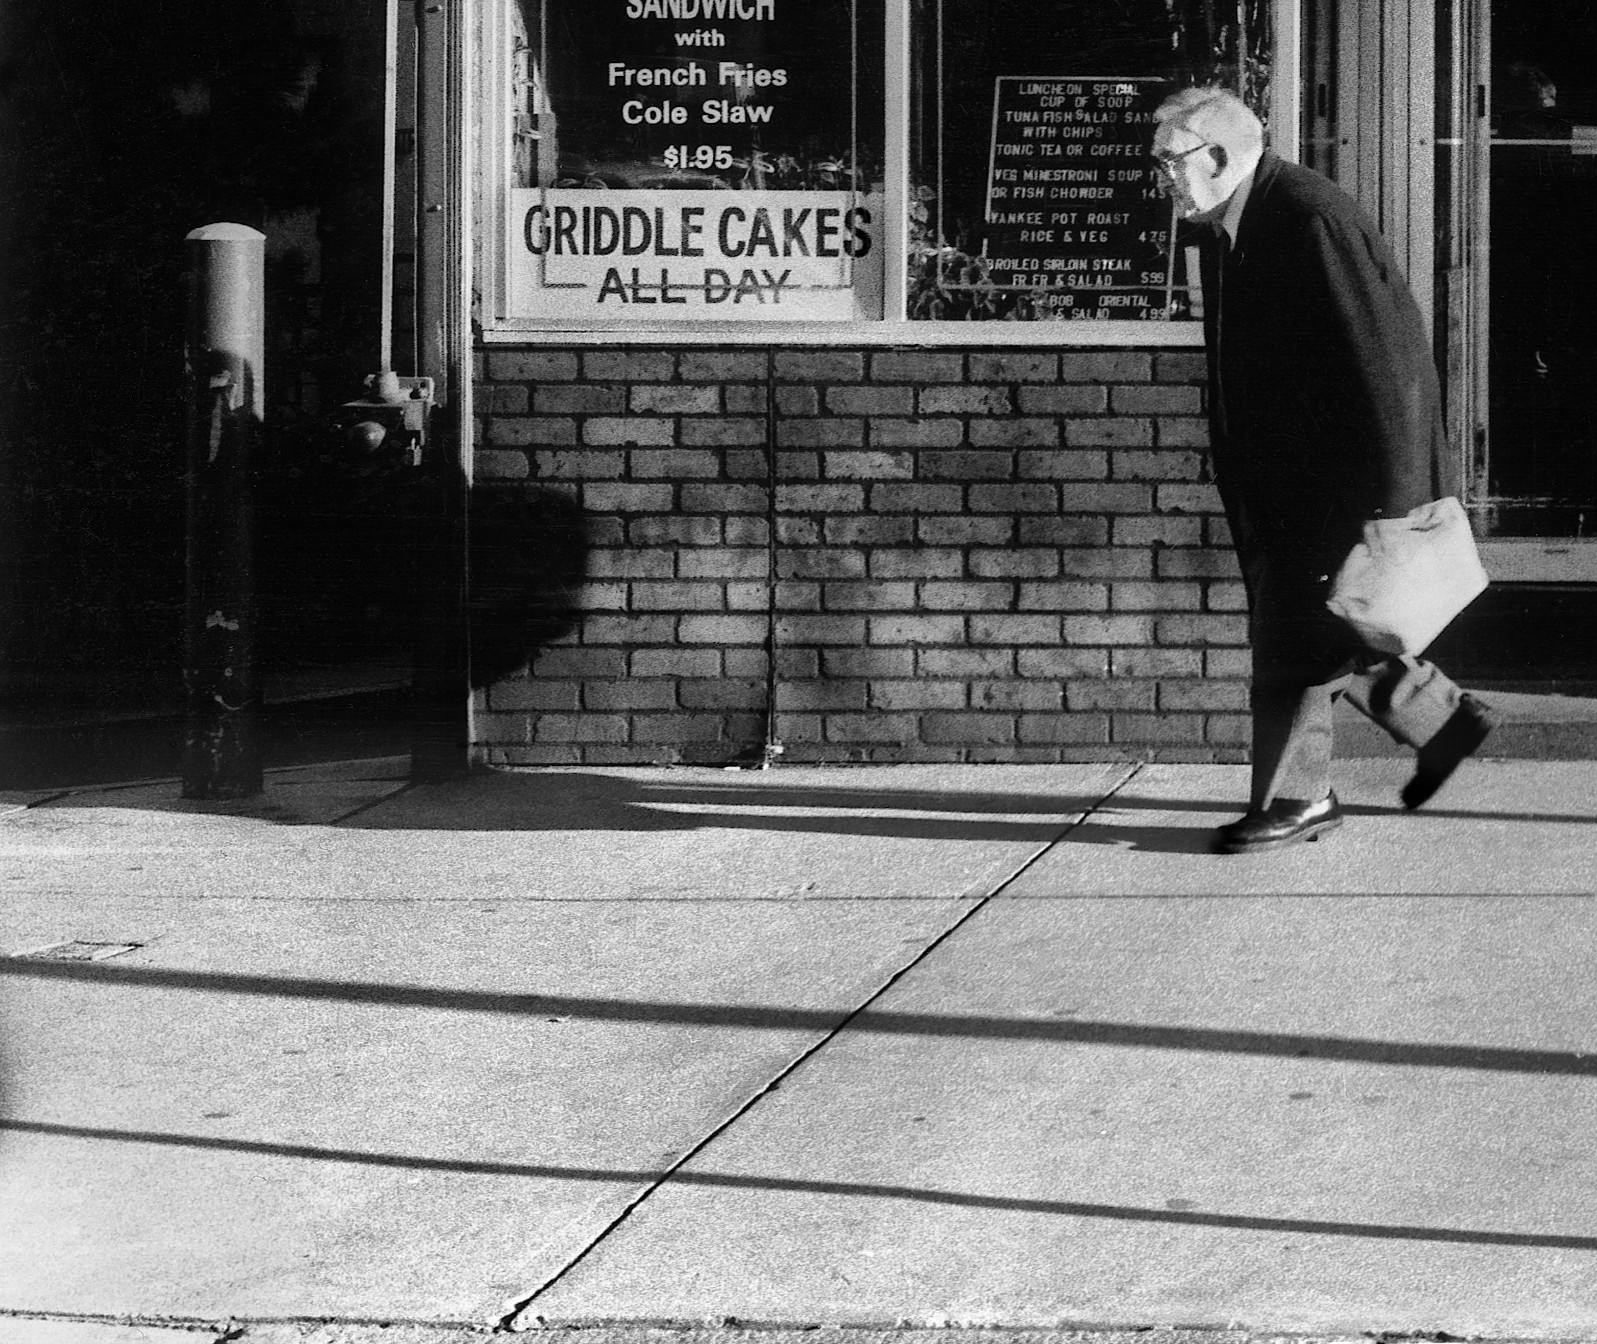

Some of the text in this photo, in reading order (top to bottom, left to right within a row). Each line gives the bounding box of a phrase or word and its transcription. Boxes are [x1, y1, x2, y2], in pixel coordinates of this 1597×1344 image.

[674, 30, 725, 47] with
[608, 62, 787, 87] French Fries
[1019, 84, 1082, 95] LUNCHEON
[1040, 97, 1133, 107] CUP OF SOUP
[622, 100, 774, 124] Cole Slaw
[1005, 111, 1039, 122] TUNA
[1043, 111, 1072, 122] FISH
[1075, 109, 1117, 123] SALAD
[1023, 126, 1103, 138] WITH CHIPS
[996, 144, 1142, 156] TONIC TEA OR COFFEE
[664, 144, 733, 170] $1.95
[995, 170, 1017, 181] VEG
[1108, 170, 1143, 181] SOUP
[992, 188, 1007, 199] OR
[1013, 188, 1044, 199] FISH
[1050, 188, 1114, 199] CHOWDER
[991, 213, 1130, 224] YANKEE POT ROAST
[524, 204, 872, 258] GRIDDLE CAKES
[1020, 231, 1054, 242] RICE
[1064, 231, 1072, 242] &
[1080, 231, 1109, 242] VEG
[987, 259, 1039, 271] BROILED
[1093, 259, 1131, 271] STEAK
[597, 267, 792, 304] ALL DAY
[1012, 275, 1026, 286] FR
[1032, 275, 1048, 286] FR
[1068, 275, 1112, 286] SALAD
[1072, 308, 1110, 319] SALAD
